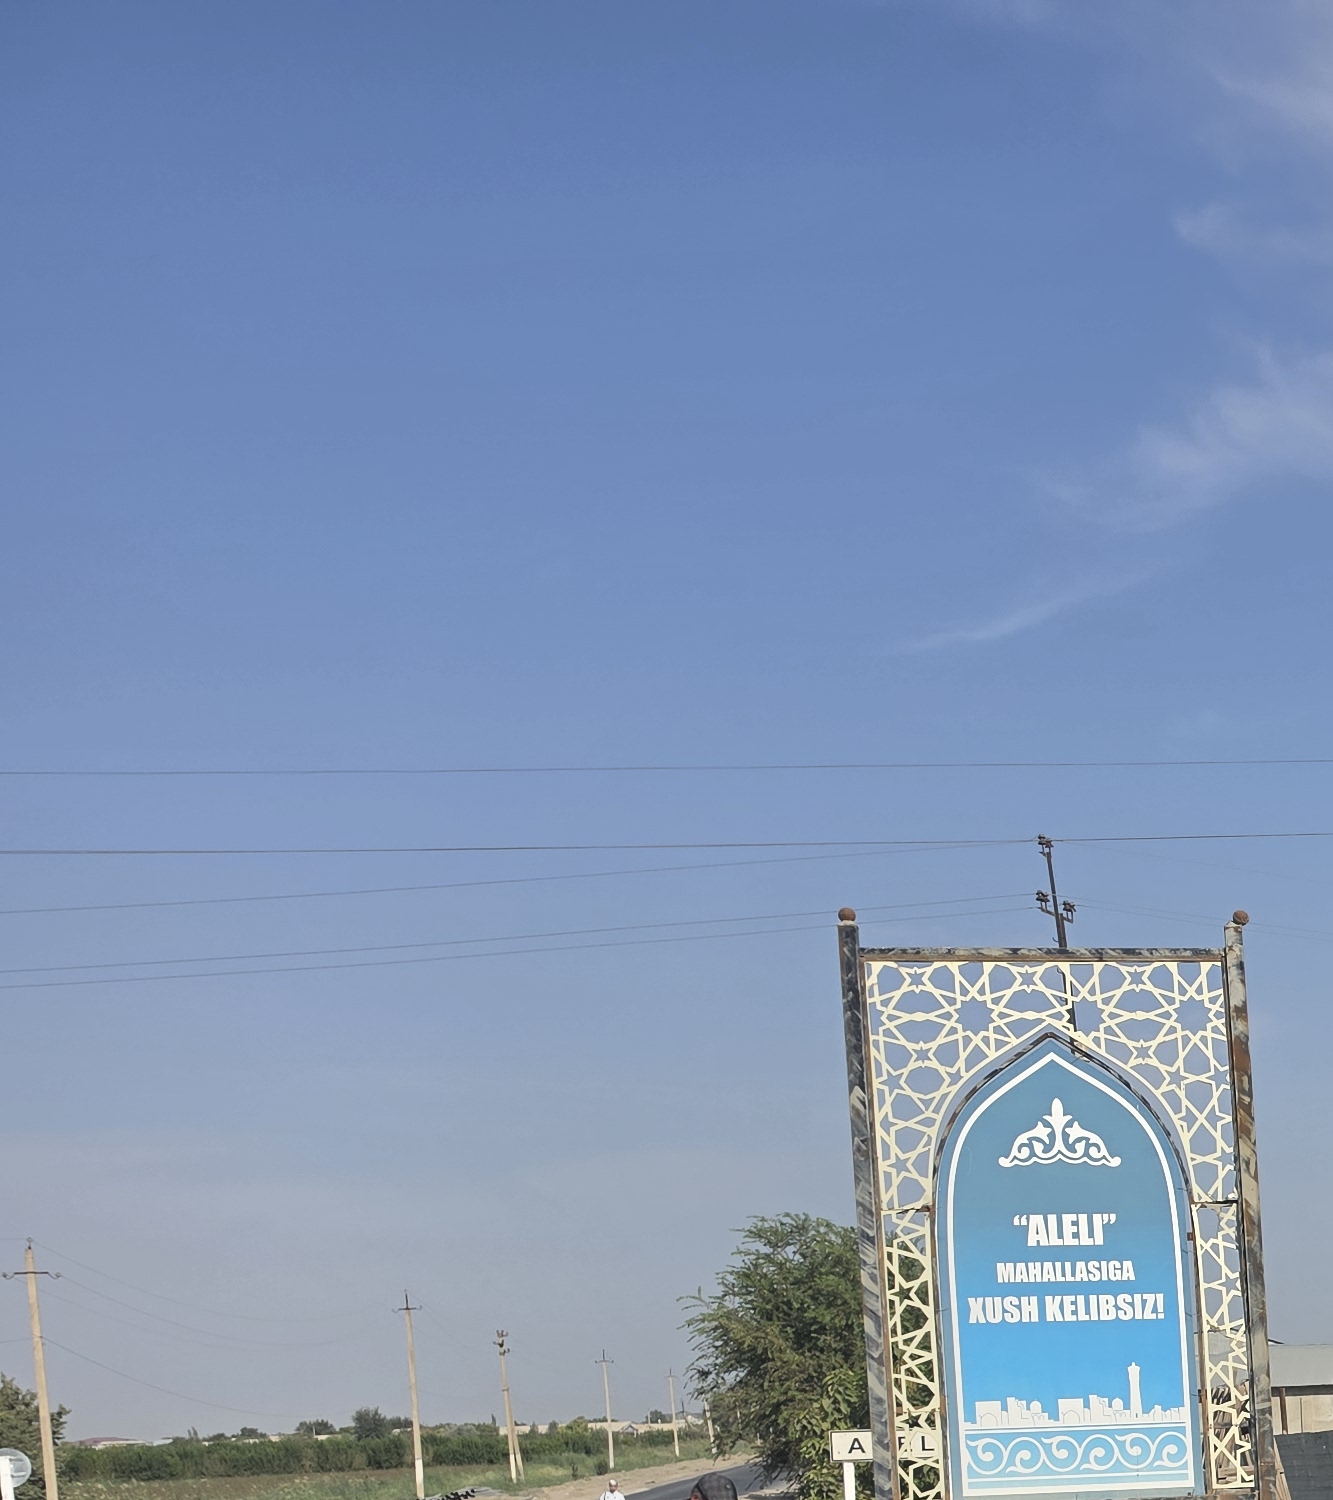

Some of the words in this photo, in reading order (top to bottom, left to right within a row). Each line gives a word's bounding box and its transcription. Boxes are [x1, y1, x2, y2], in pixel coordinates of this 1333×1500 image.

[996, 1260, 1136, 1283] MAHALLASIGA
[967, 1296, 1039, 1324] XUSH
[1044, 1293, 1165, 1322] KELIBSIZ!
